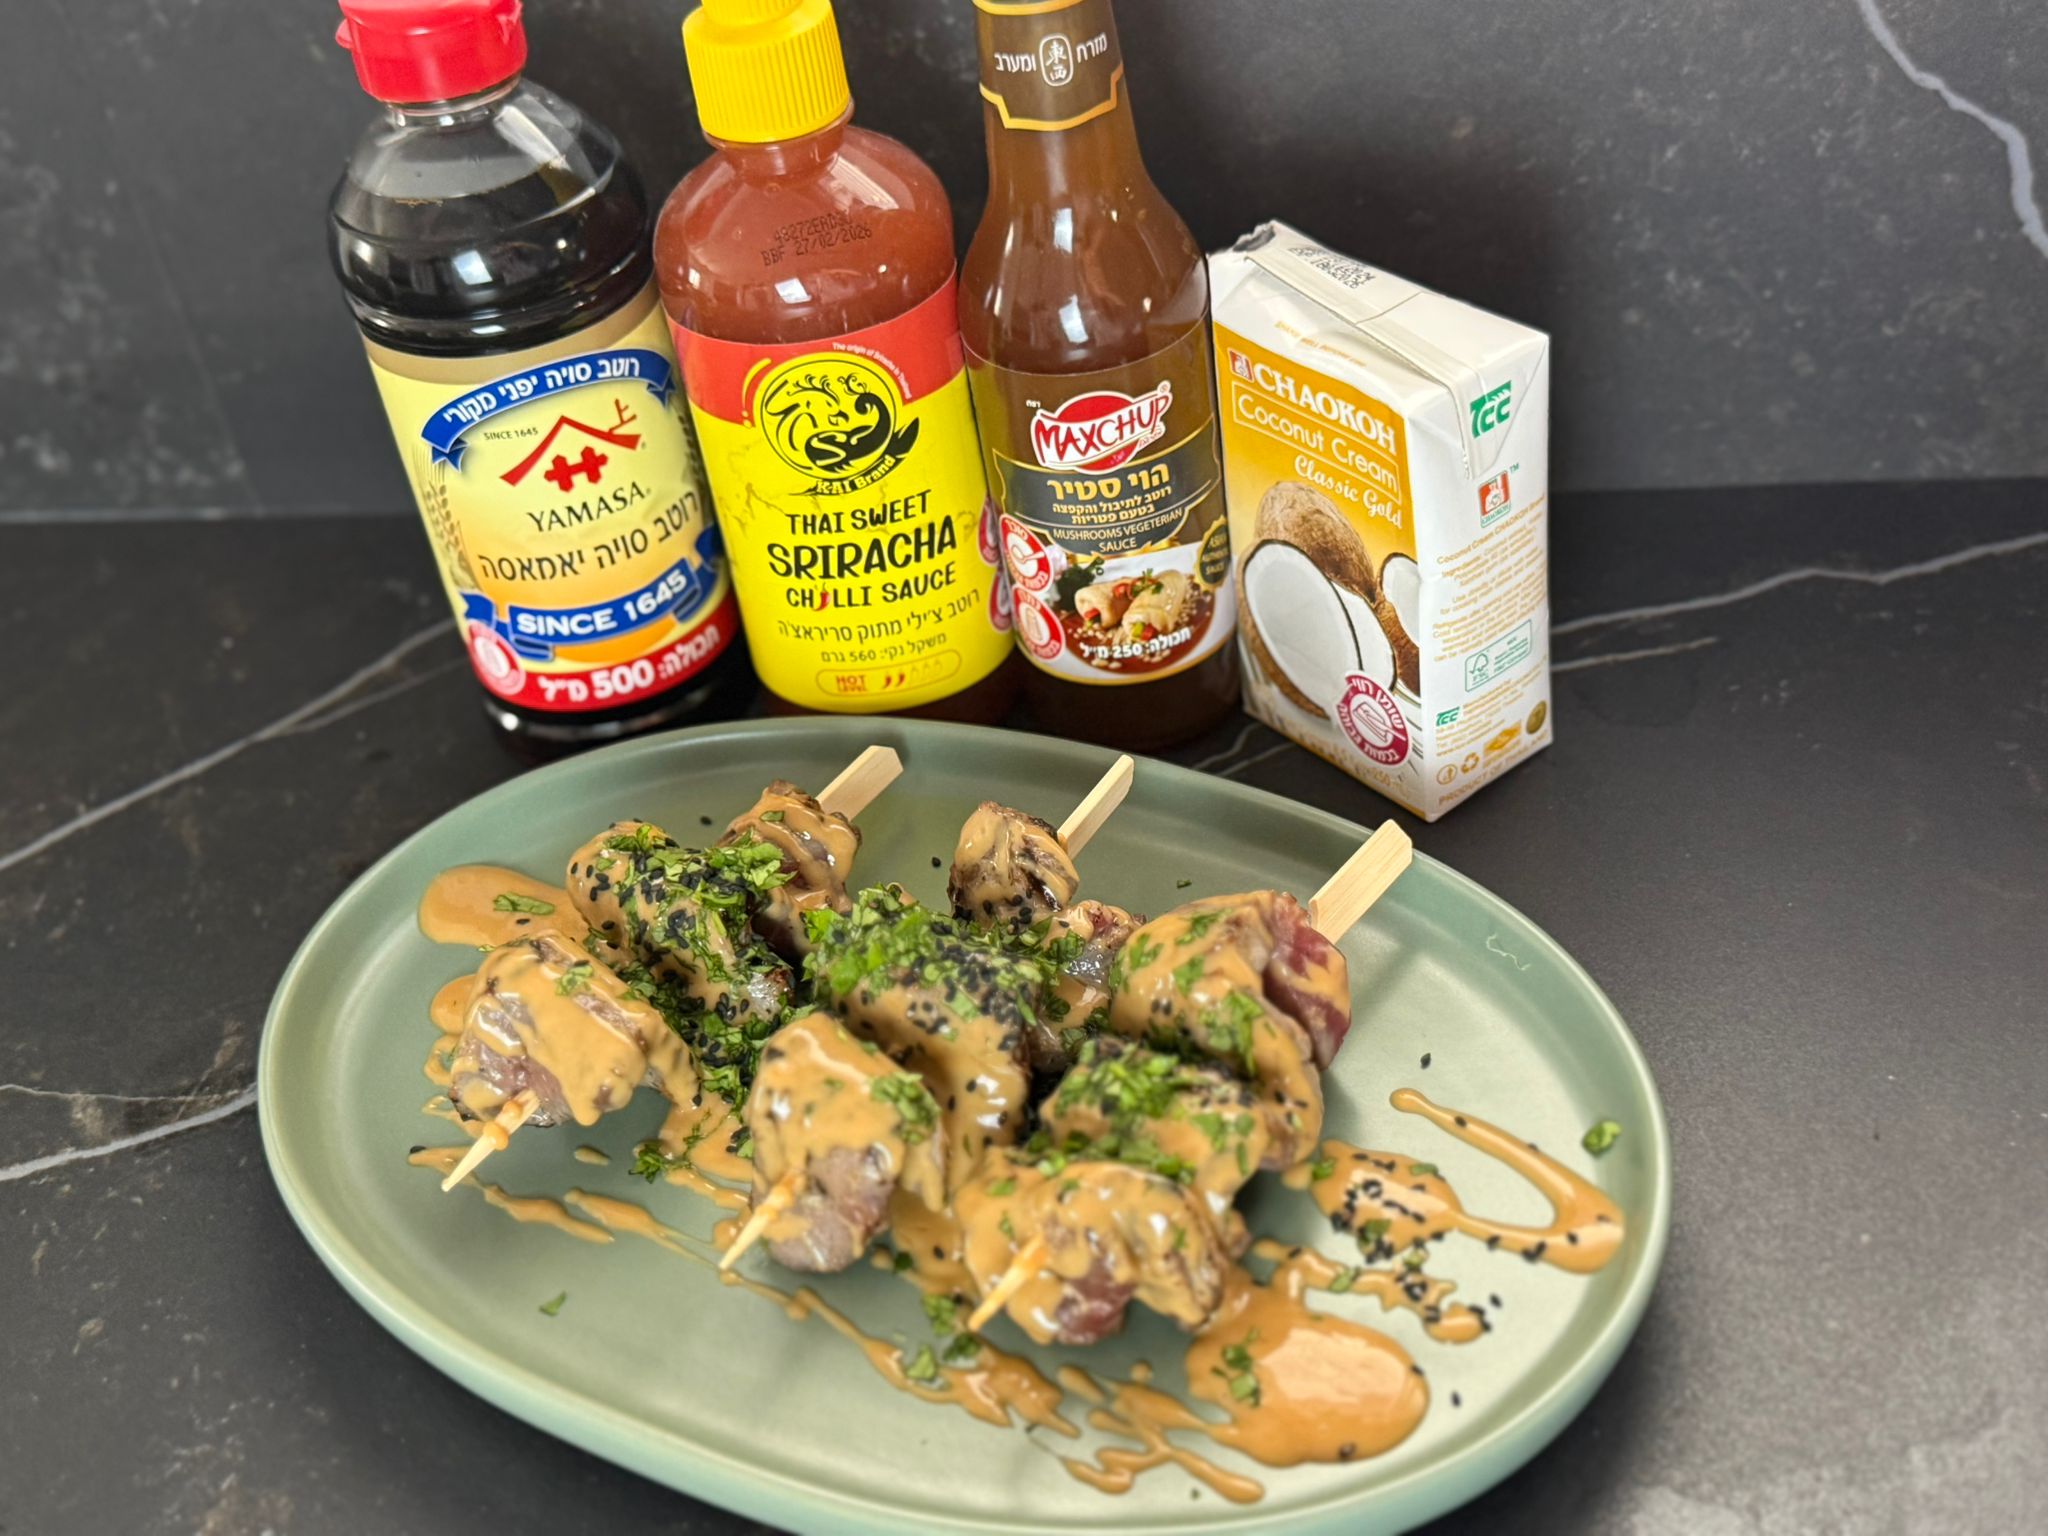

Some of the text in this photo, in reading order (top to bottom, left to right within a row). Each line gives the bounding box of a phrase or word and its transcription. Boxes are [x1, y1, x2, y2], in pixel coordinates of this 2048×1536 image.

[994, 32, 1108, 73] מזרח ומערב
[443, 356, 640, 423] רוטב סויה יפני מקורי
[1253, 362, 1397, 456] CHAOKOH
[483, 427, 539, 441] SINCE 1645
[1034, 395, 1169, 464] MAXCHUP
[1238, 394, 1399, 493] Coconut Cream
[816, 454, 896, 495] KAI Brand
[1046, 463, 1170, 501] הוי סטיר
[1295, 456, 1402, 529] Classic Gold
[526, 480, 647, 533] YAMASA
[786, 490, 932, 535] THAI SWEET
[1052, 485, 1172, 516] רוטב לתיבול והקפצה
[1071, 503, 1155, 525] בטעם פטריות
[477, 492, 699, 582] רוטב סויה יאמאסה
[1053, 508, 1182, 541] MUSHROOMS VEGETERIAN
[1099, 537, 1137, 552] SAUCE
[767, 515, 957, 580] SRIRACHA
[516, 569, 687, 636] SINCE 1645
[786, 561, 956, 609] CHILLI SAUCE
[947, 588, 980, 618] רוטב
[658, 624, 721, 680] תכולה:
[821, 632, 947, 663] משקל נקי: 560 גרם
[857, 619, 902, 644] מתוק
[1112, 643, 1142, 658] 250
[1145, 626, 1191, 654] תכולה:
[592, 659, 655, 700] 500
